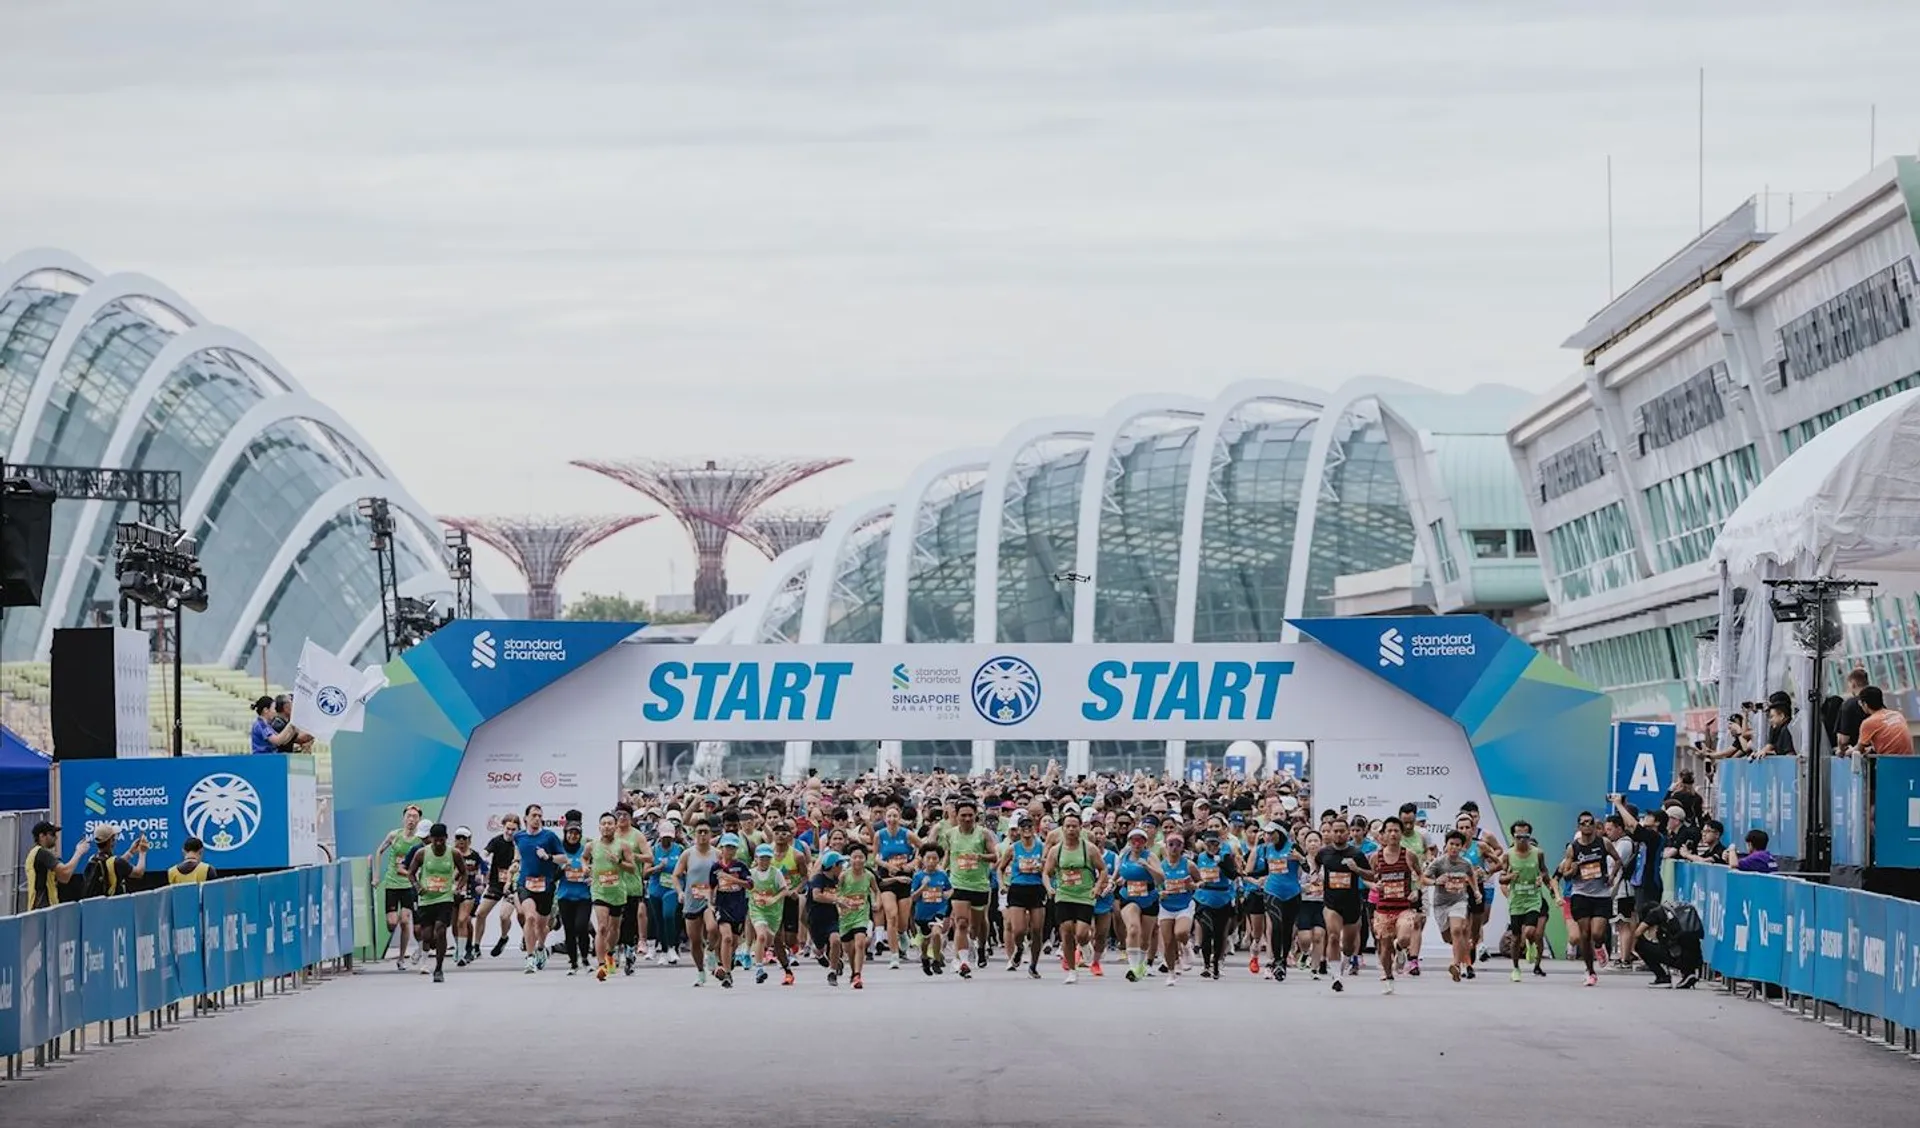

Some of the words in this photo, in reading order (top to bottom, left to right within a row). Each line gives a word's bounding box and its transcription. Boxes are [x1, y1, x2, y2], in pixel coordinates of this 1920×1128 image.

[503, 638, 563, 650] standard
[1411, 633, 1472, 646] standard
[503, 649, 567, 661] chartered
[1411, 644, 1476, 657] chartered
[915, 667, 959, 676] standard
[915, 675, 961, 684] chartered
[642, 661, 854, 722] START
[1081, 660, 1295, 721] START
[892, 694, 961, 704] SINGAPORE
[891, 704, 961, 712] MARATHON
[1406, 765, 1450, 776] SEIKO
[1628, 752, 1660, 792] A
[487, 771, 522, 783] Sport
[112, 785, 166, 798] standard
[112, 795, 169, 807] chartered
[1427, 823, 1453, 834] CTIVE
[85, 830, 168, 841] MATON
[147, 840, 168, 850] 024
